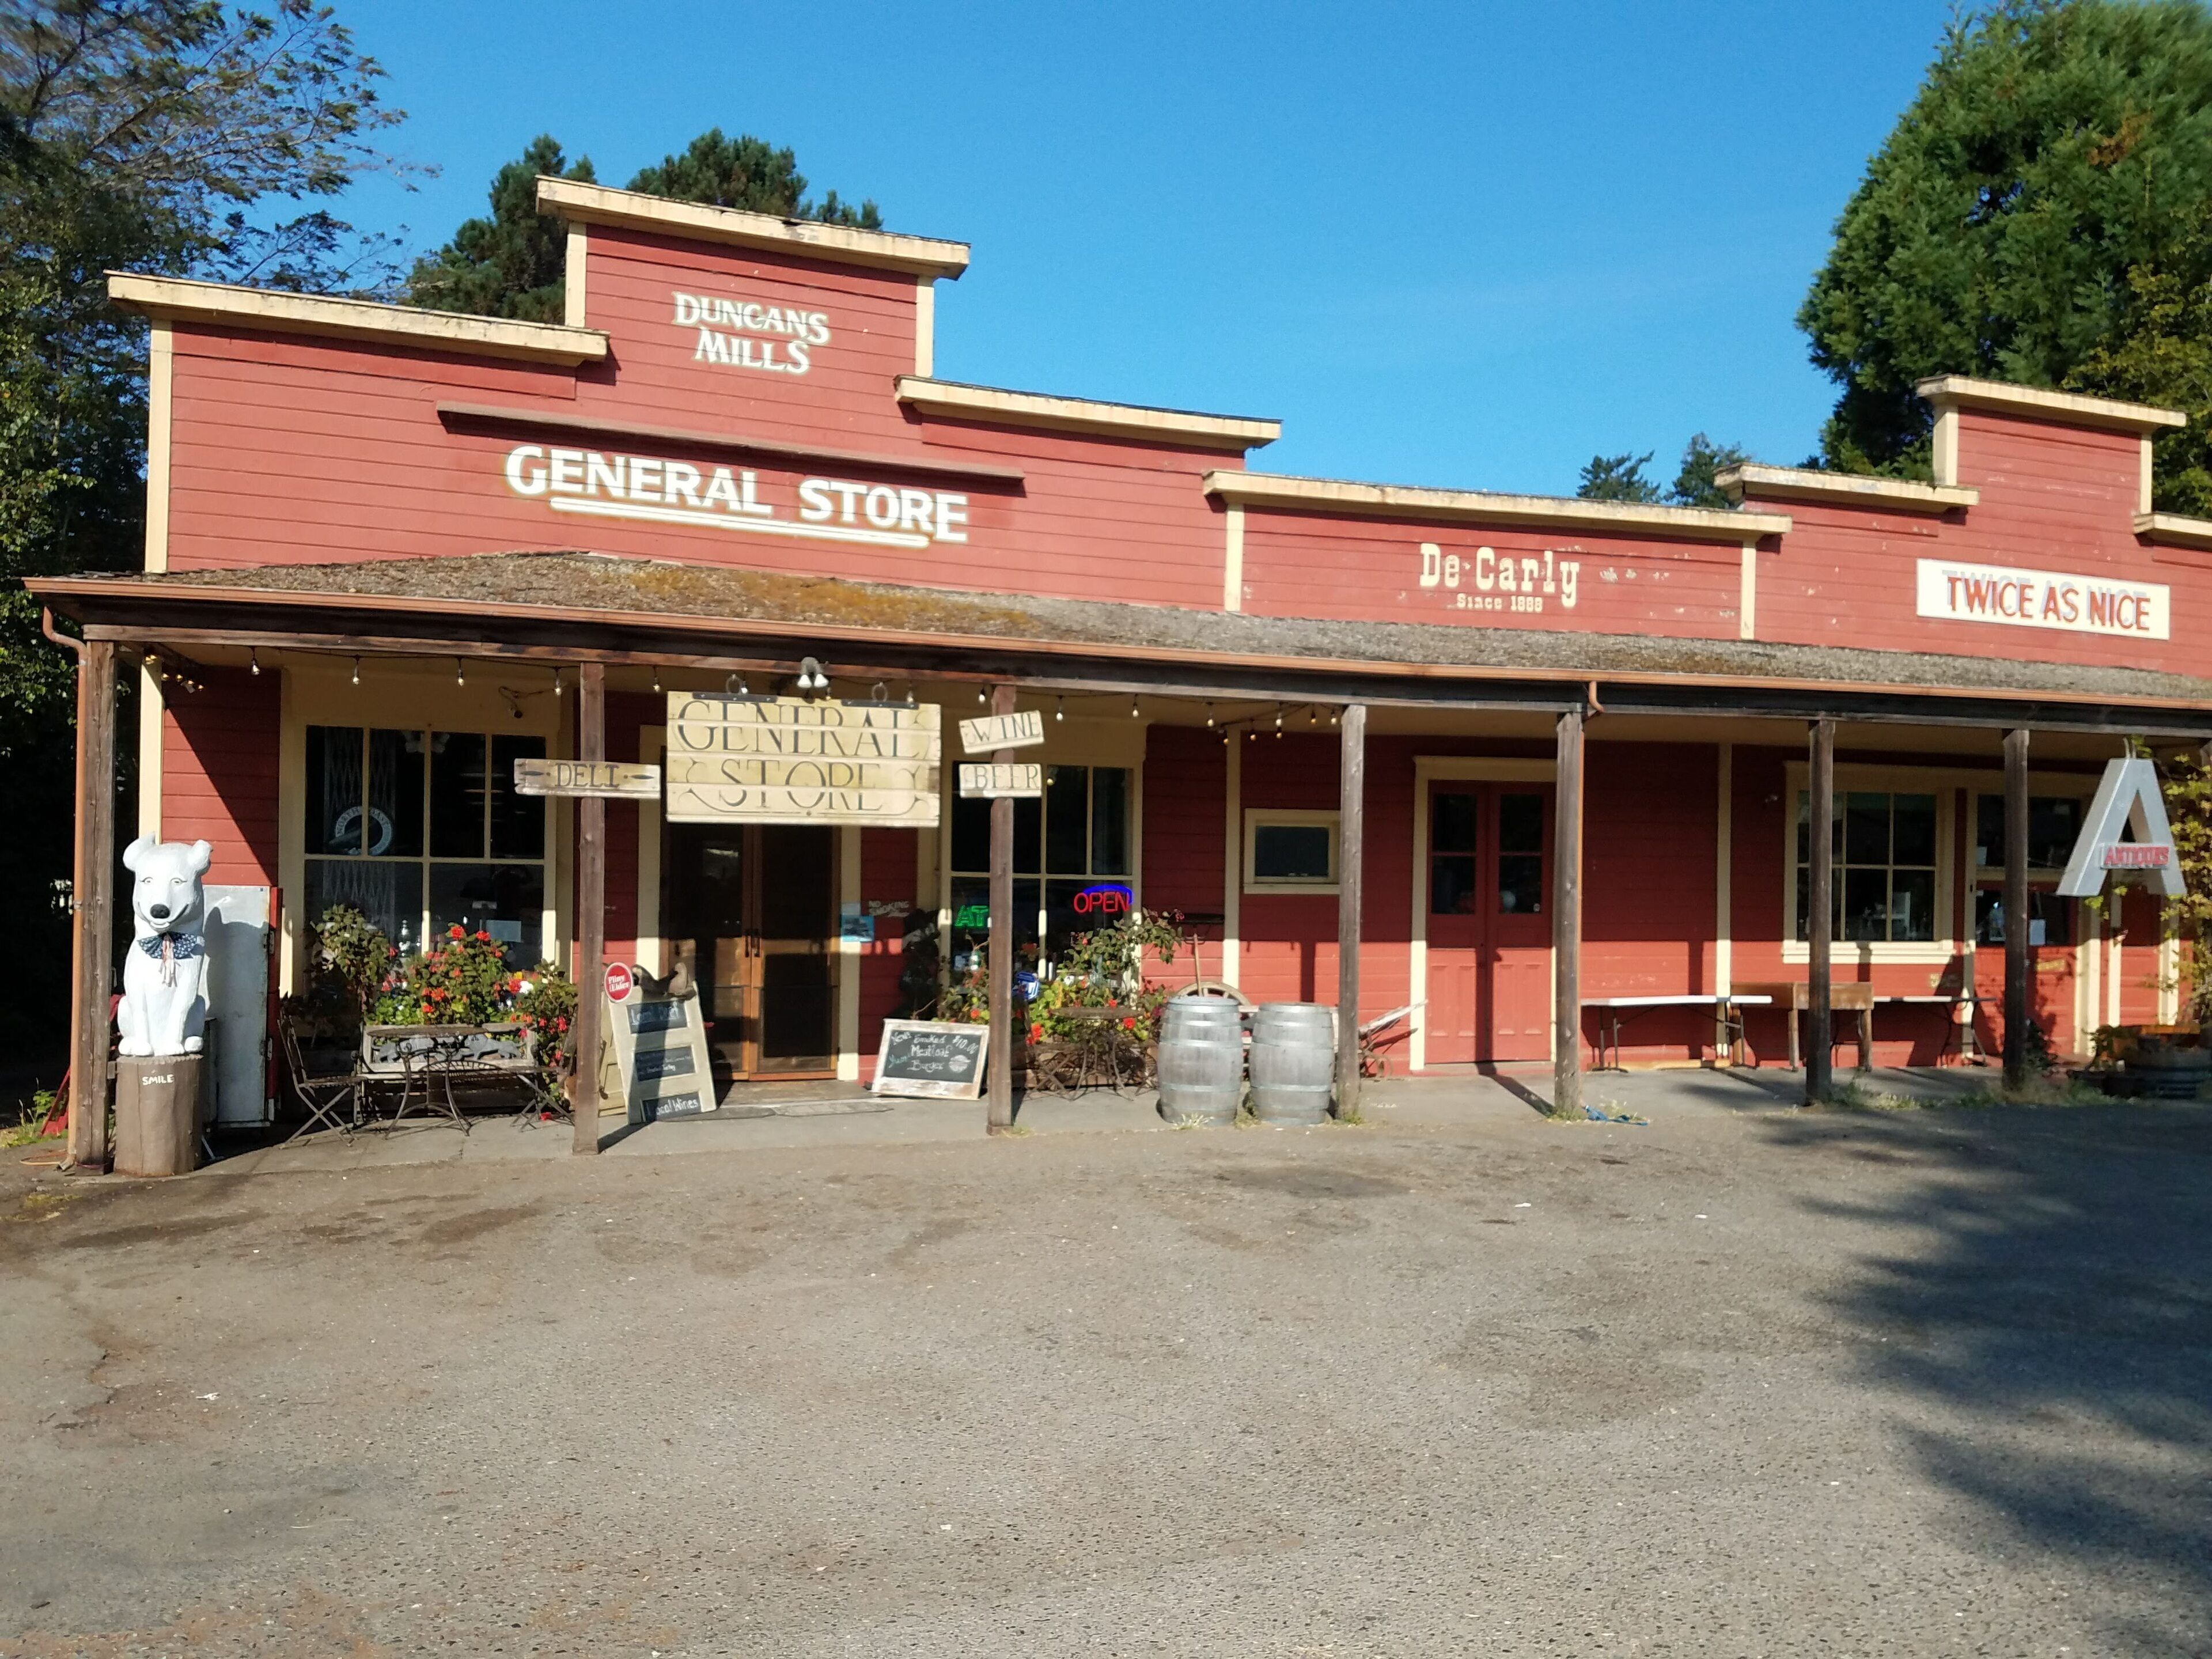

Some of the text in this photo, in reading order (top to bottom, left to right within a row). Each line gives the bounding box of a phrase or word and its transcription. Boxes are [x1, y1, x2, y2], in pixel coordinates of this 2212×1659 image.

[673, 292, 831, 347] DUNCANS
[694, 325, 810, 374] MILLS
[505, 445, 969, 544] GENERAL STORE
[1476, 547, 1580, 607] Carly
[1457, 593, 1502, 609] Since
[1945, 573, 2151, 631] TWICE AS NICE
[970, 713, 1040, 741] WINE
[677, 700, 917, 812] GENERAL STORE
[555, 763, 619, 789] DELI
[973, 765, 1040, 789] BEER
[2104, 846, 2169, 866] ANTIQUES
[954, 904, 989, 927] AT
[1073, 892, 1129, 914] OPEN
[911, 1044, 953, 1057] Meatloaf
[142, 1074, 175, 1086] SMILE
[672, 1097, 699, 1112] Wines
